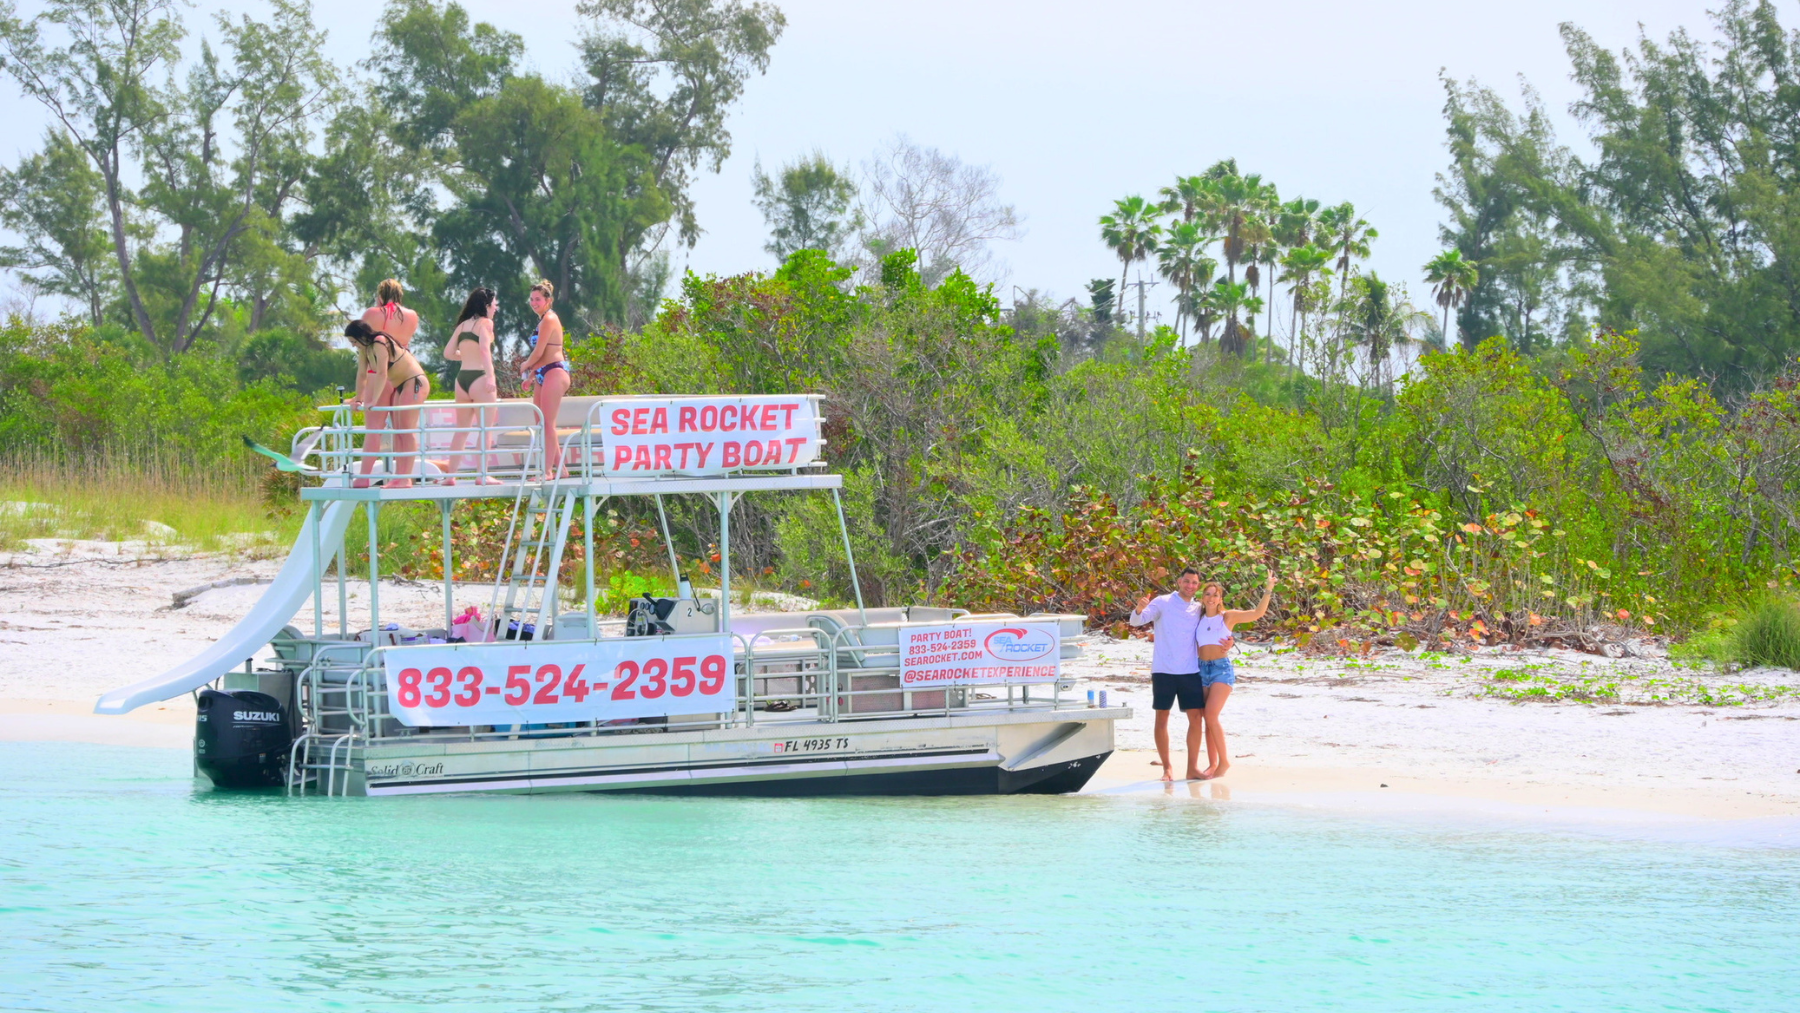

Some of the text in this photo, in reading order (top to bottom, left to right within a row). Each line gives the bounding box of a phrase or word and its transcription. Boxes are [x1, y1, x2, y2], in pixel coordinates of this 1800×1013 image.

[611, 404, 799, 435] SEA ROCKET
[612, 442, 714, 470] PARTY
[721, 438, 807, 468] BOAT
[687, 607, 692, 617] 2
[910, 628, 972, 643] PARTY BOAT!
[993, 636, 1012, 644] SEA
[909, 640, 976, 655] 833-524-2359
[1004, 643, 1048, 653] ROCKET
[904, 651, 983, 667] SEAROCKET.COM
[397, 655, 726, 708] 833-524-2359
[904, 666, 1056, 683] @SEAROCKETEXPERIENCE
[233, 711, 280, 722] SUZUKI
[784, 741, 799, 752] FL
[804, 739, 832, 751] 4935
[836, 738, 849, 749] TS
[370, 762, 444, 775] Solid Craft
